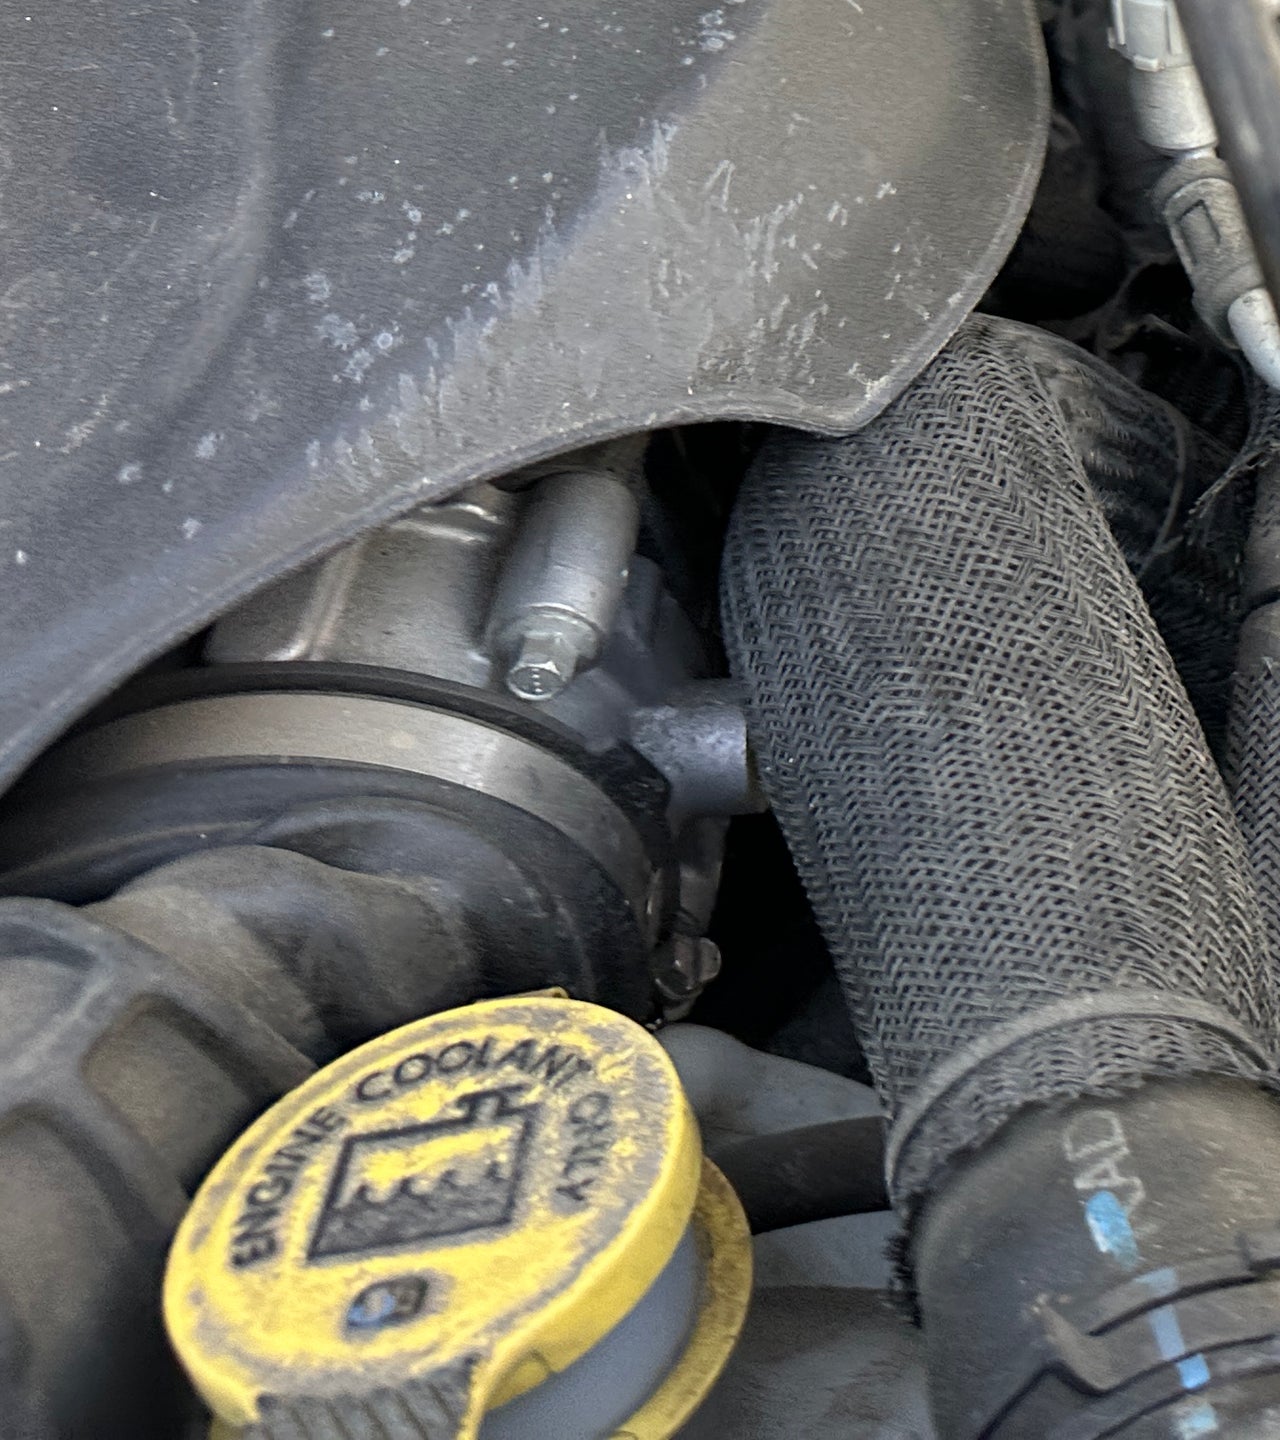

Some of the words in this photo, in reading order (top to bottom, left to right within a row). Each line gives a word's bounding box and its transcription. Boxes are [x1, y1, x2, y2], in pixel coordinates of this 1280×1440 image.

[231, 1106, 347, 1270] ENGINE
[356, 1034, 594, 1102] COOLANT
[554, 1090, 612, 1202] ONLY
